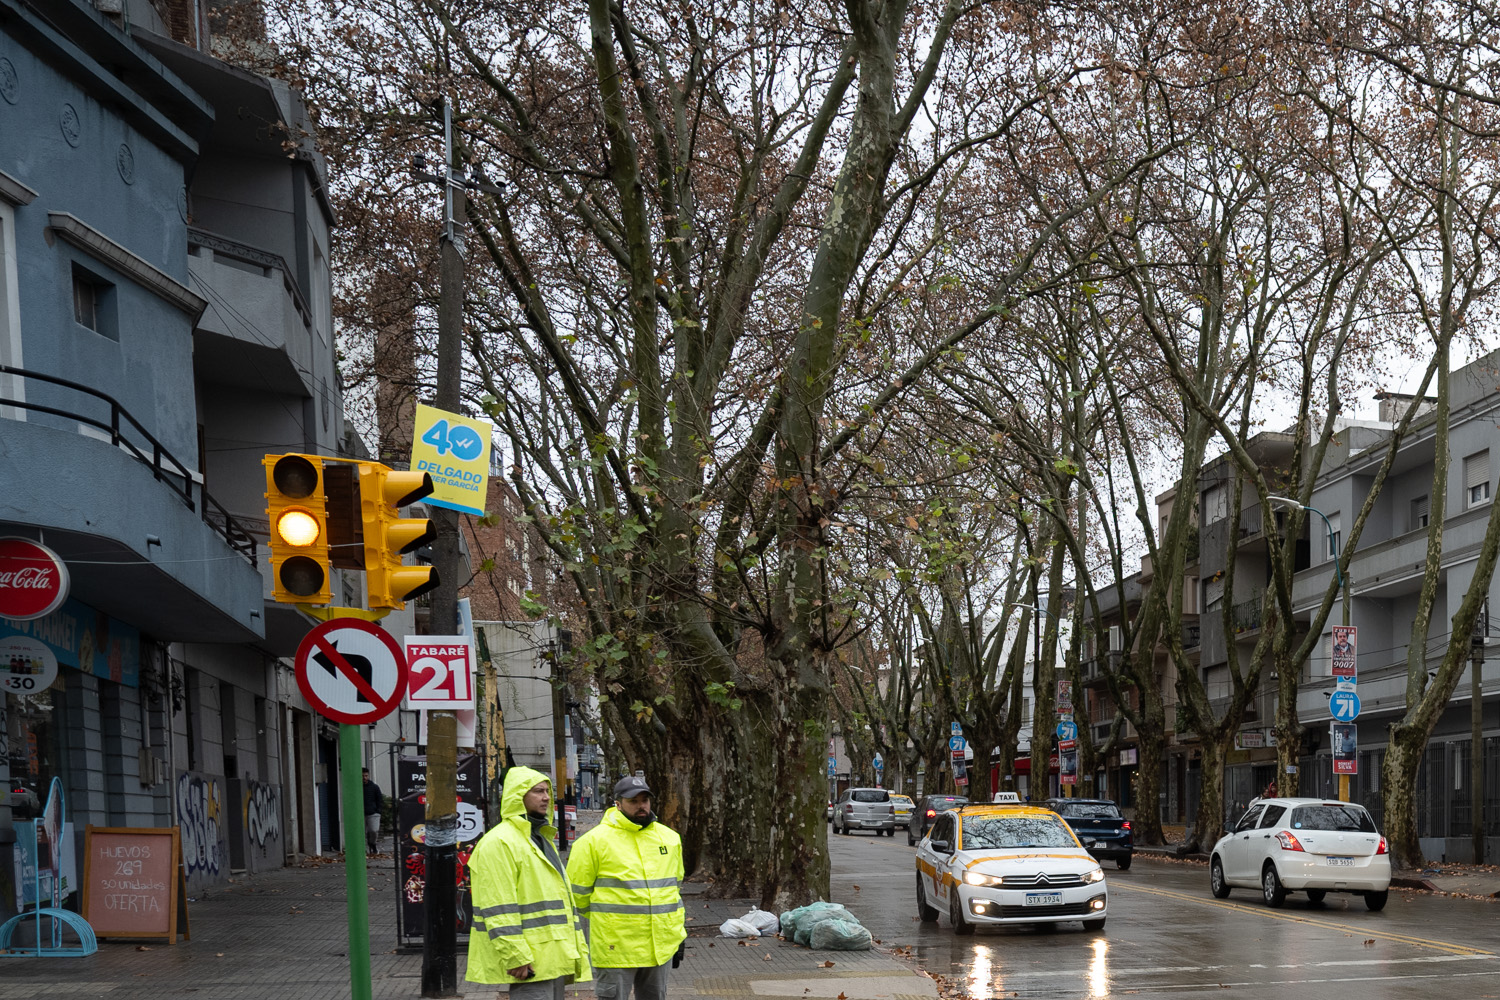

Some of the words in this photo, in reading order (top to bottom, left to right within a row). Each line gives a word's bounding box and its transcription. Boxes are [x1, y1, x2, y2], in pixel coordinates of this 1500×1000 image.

[422, 419, 484, 462] 40
[417, 460, 483, 485] DELGADO
[447, 479, 479, 493] GARCÍA
[410, 645, 466, 656] TABARÉ
[5, 677, 35, 690] $30
[411, 656, 468, 700] 21
[1336, 699, 1354, 718] 71
[1061, 726, 1074, 740] 71
[952, 740, 963, 751] 71
[100, 846, 151, 859] HUEVOS
[114, 860, 142, 875] 269
[101, 879, 117, 890] 30
[118, 879, 166, 891] unidades
[104, 893, 160, 913] OFERTA
[1028, 896, 1041, 904] STX
[1043, 895, 1060, 903] 1934
